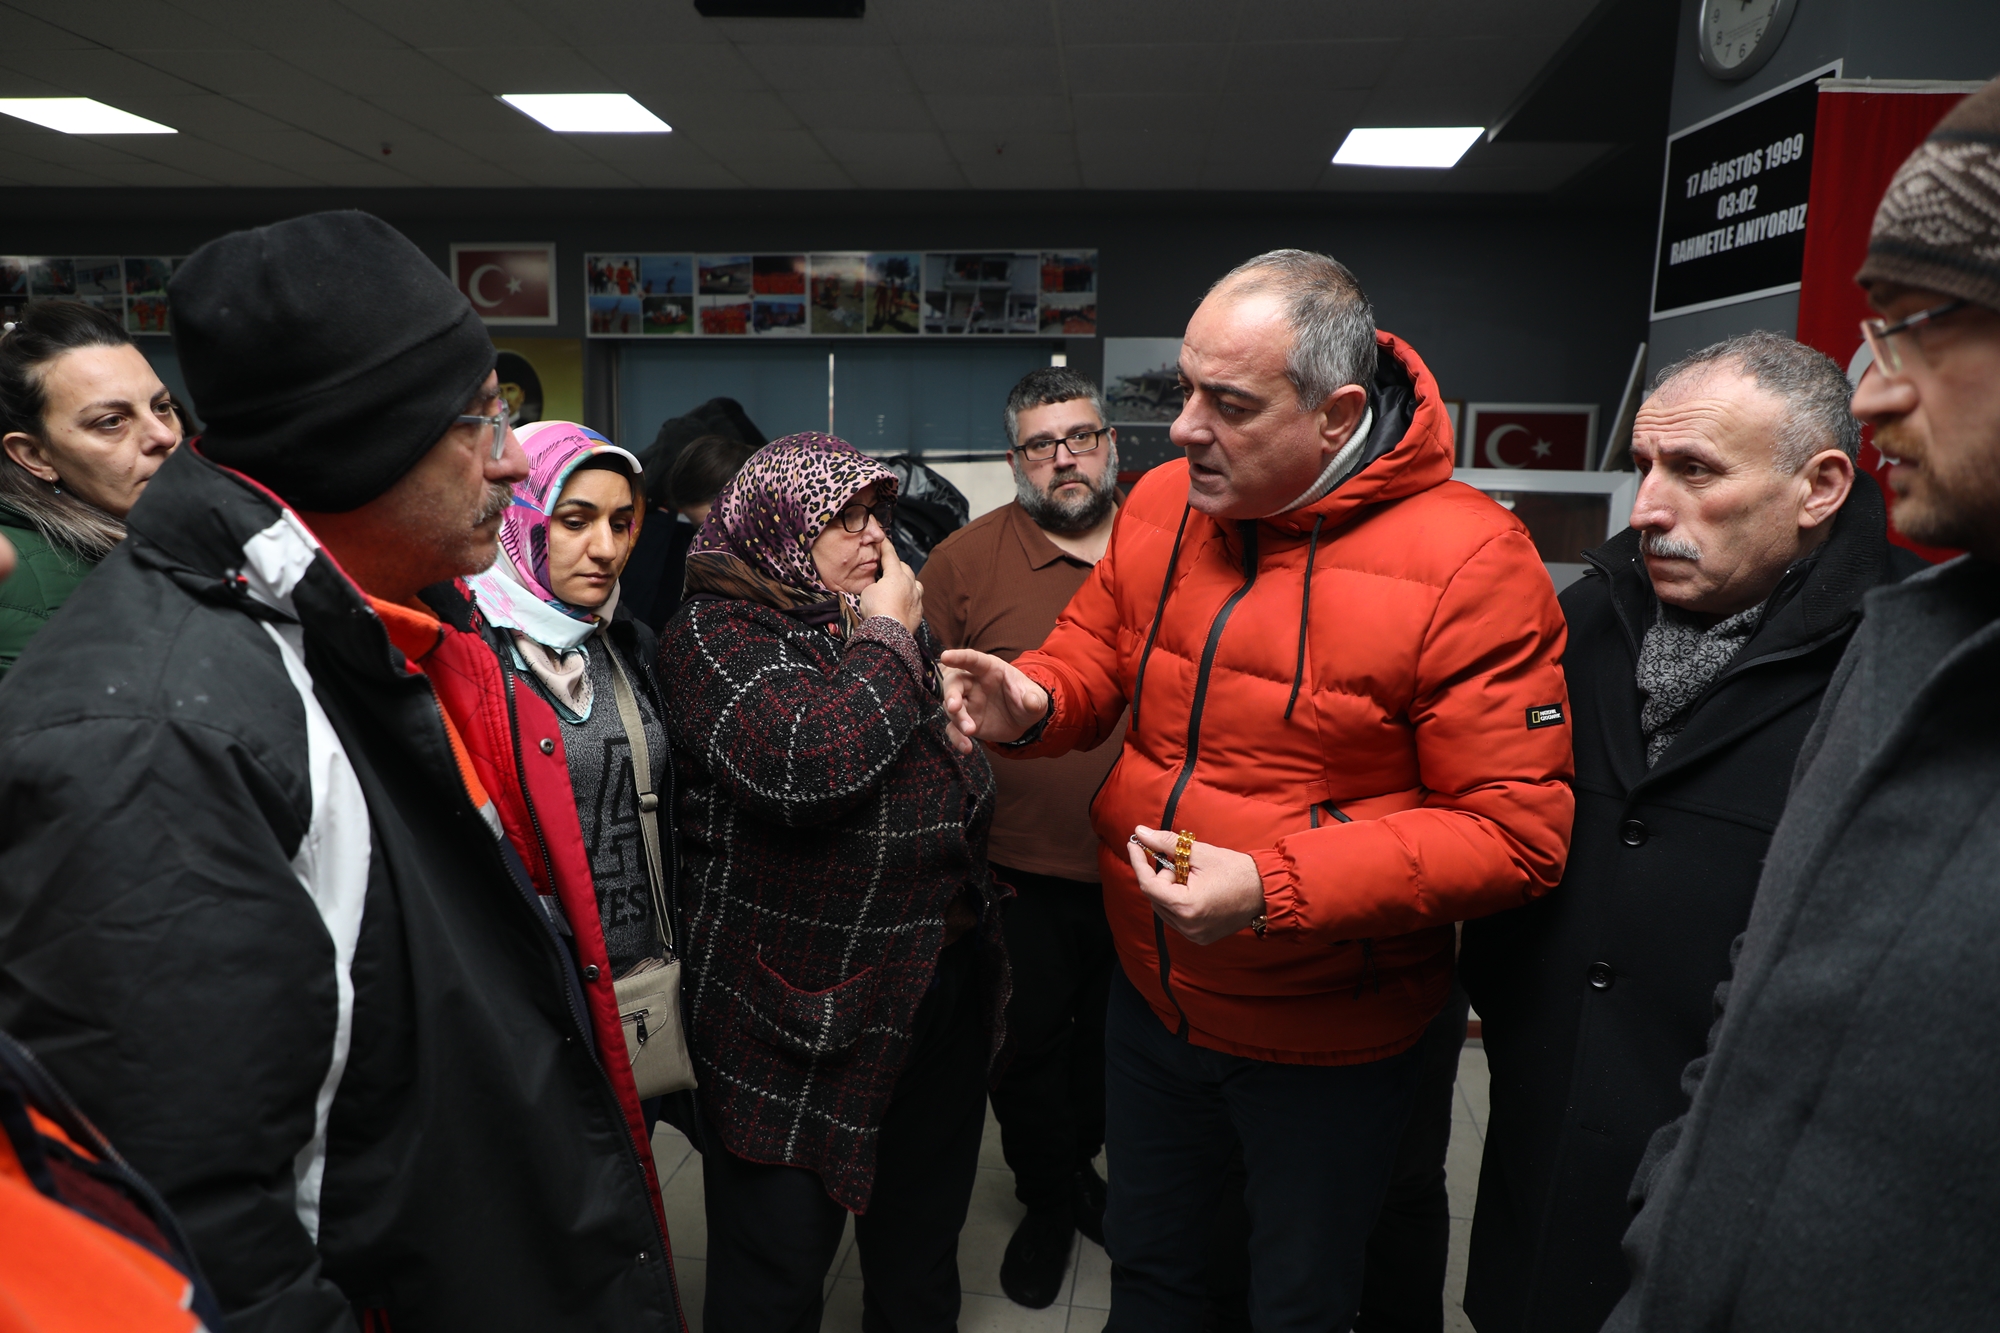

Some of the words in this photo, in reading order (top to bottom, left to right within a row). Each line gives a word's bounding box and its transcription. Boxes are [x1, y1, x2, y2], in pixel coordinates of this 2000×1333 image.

[1686, 172, 1700, 198] 17
[1700, 148, 1763, 194] AĞUSTOS
[1765, 133, 1804, 170] 1999
[1717, 184, 1758, 220] 03:02
[1670, 225, 1734, 266] RAHMETLE
[1734, 203, 1808, 248] ANIYORUZ
[596, 883, 648, 929] ES
